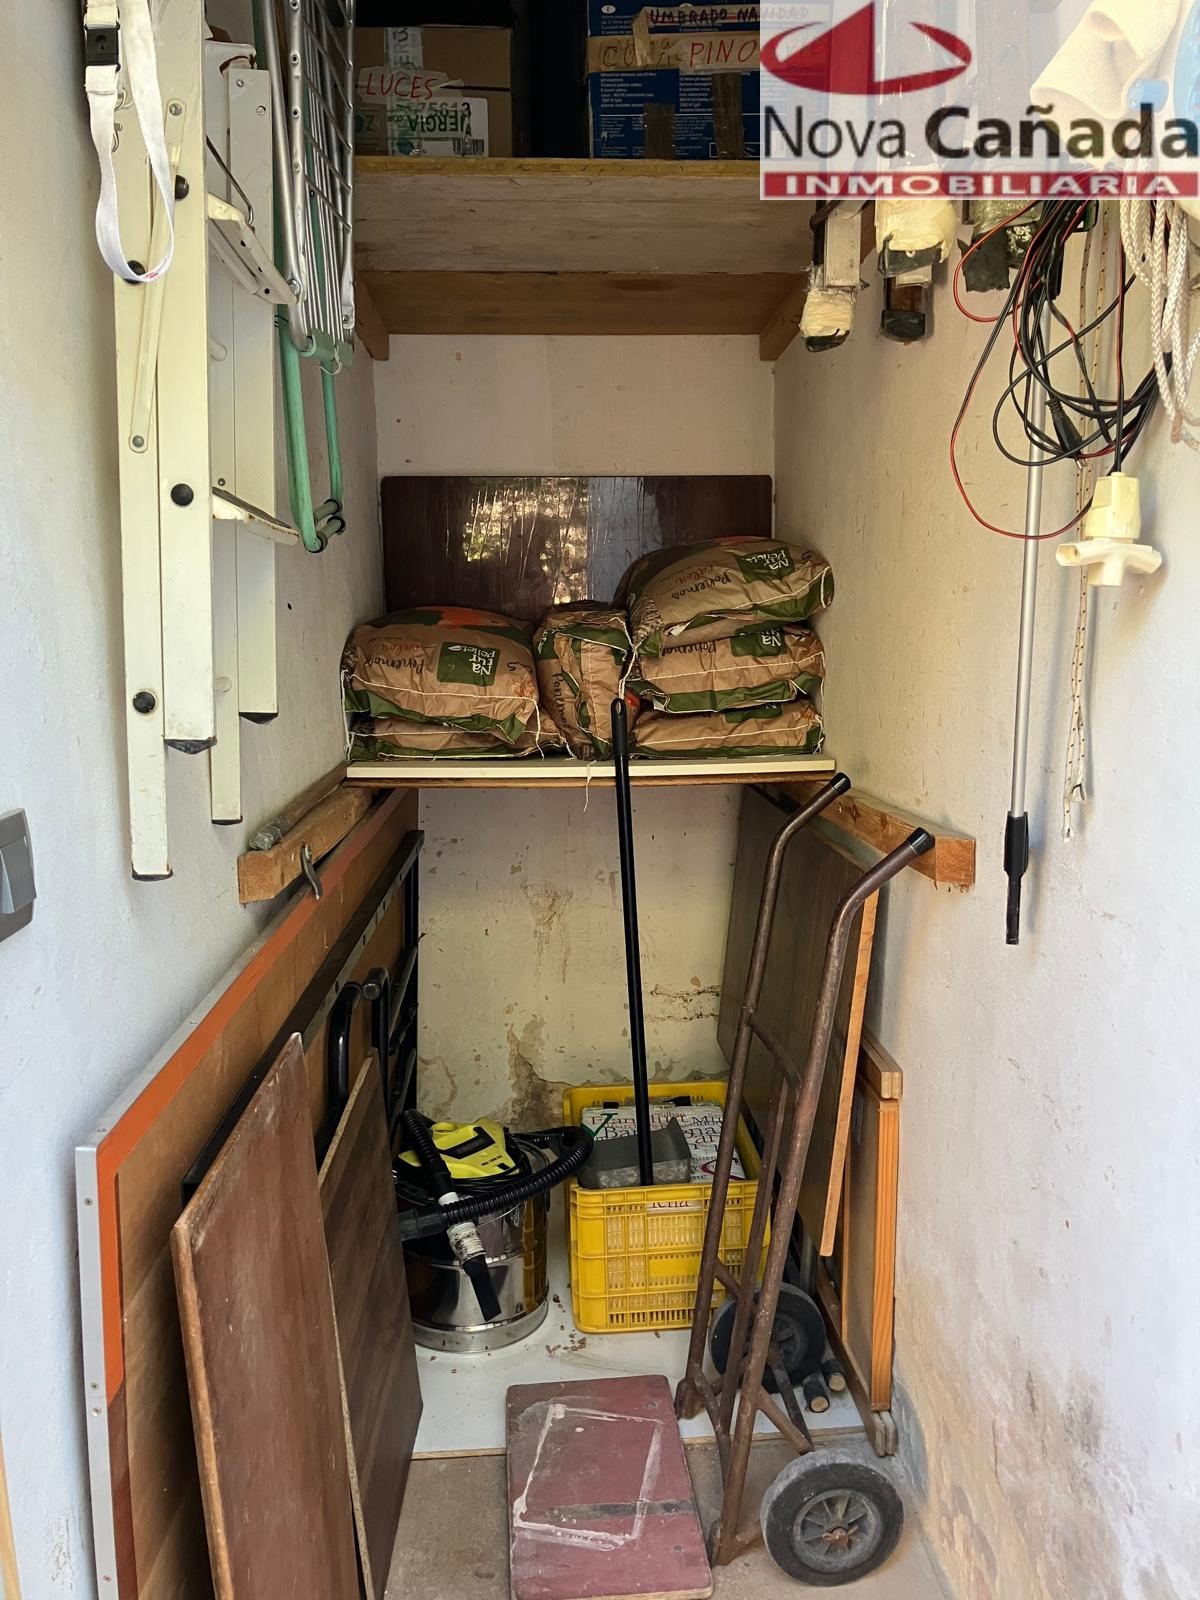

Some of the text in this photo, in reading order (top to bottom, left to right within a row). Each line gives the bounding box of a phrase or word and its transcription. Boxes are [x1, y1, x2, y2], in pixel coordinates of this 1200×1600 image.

[690, 39, 757, 67] PINO
[367, 73, 438, 100] LUCES
[761, 634, 782, 648] Na
[461, 645, 496, 658] pellet
[468, 654, 494, 667] tur
[472, 662, 493, 676] Na
